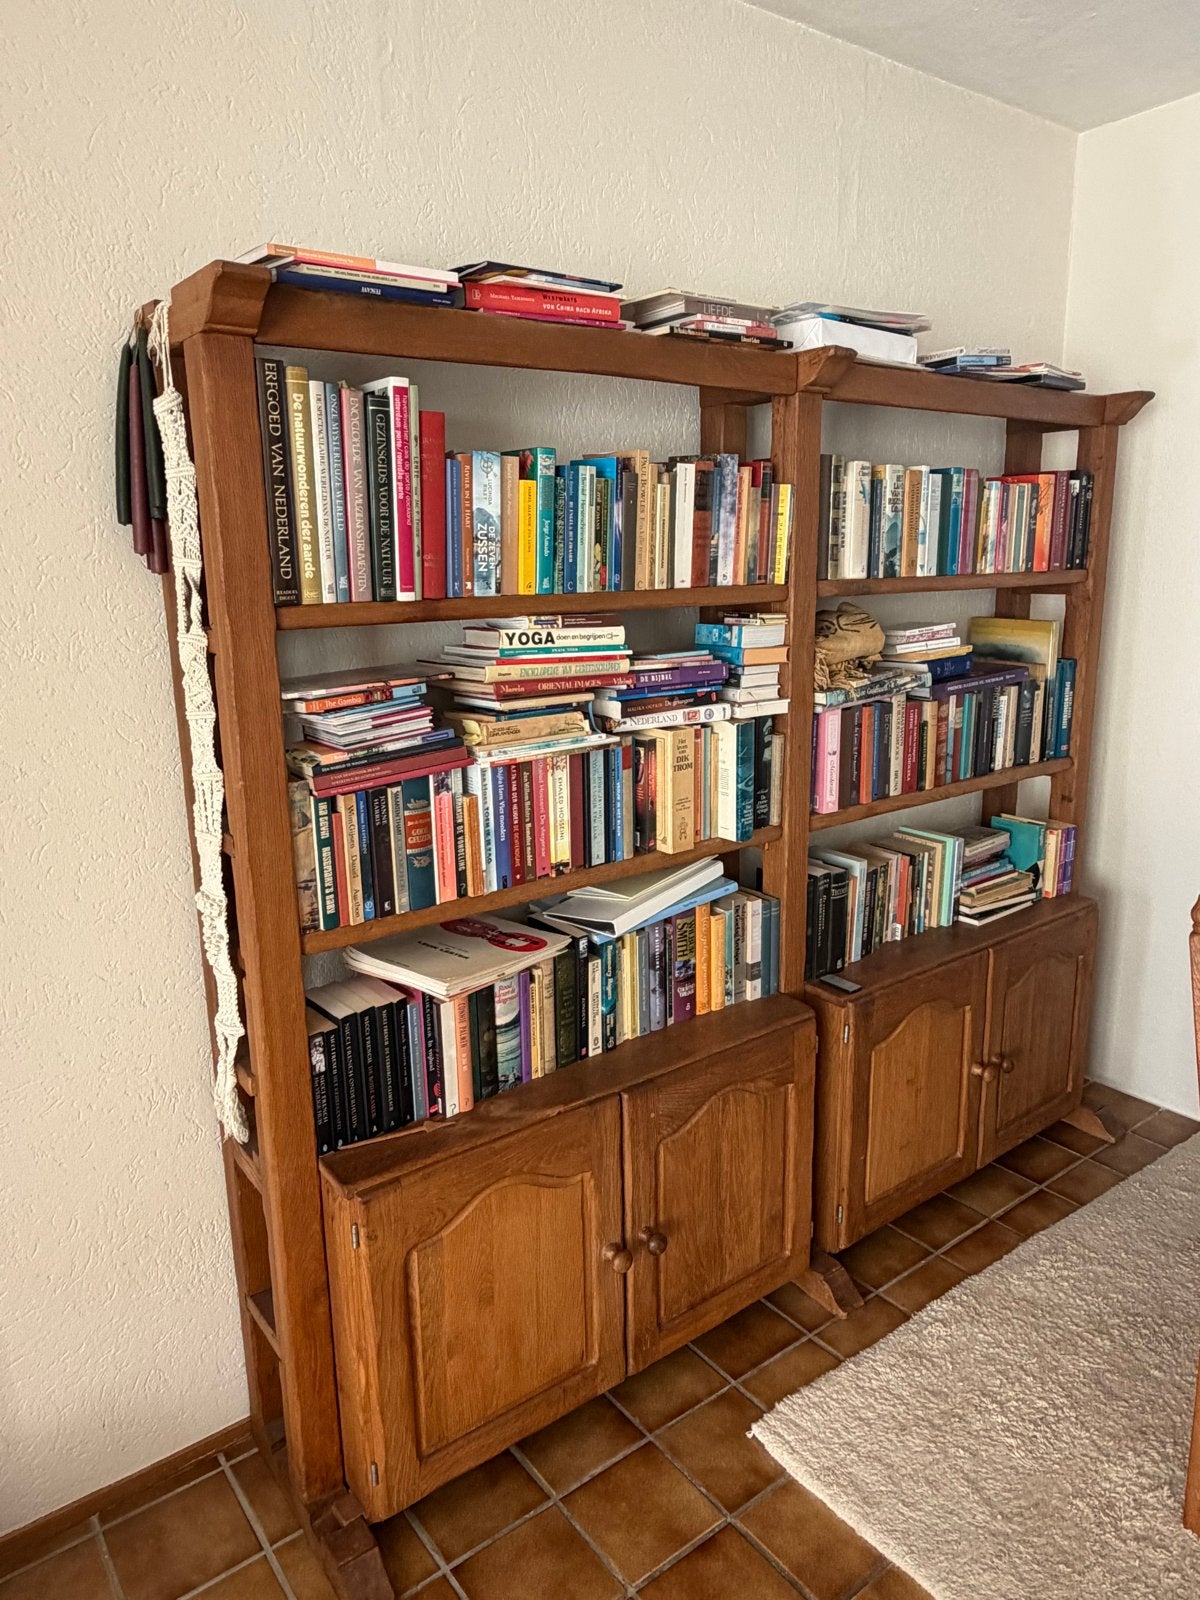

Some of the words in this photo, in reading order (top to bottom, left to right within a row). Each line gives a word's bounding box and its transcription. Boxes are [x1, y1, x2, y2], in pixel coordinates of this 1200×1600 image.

[703, 303, 735, 317] LIEFDE
[264, 363, 282, 436] ERFGOED
[293, 393, 306, 410] De
[330, 393, 339, 419] ONZE
[316, 406, 328, 467] SPECTACULAIRE
[349, 397, 361, 465] ENCYCLOPEDIE
[271, 443, 284, 477] VAN
[331, 420, 343, 488] MYSTERIEUZE
[375, 414, 388, 483] GEZINSGIDS
[293, 413, 312, 525] natuurwonderen
[354, 470, 362, 488] VAN
[640, 456, 648, 478] PAUL
[320, 468, 329, 501] WERELD
[465, 491, 470, 499] IN
[639, 479, 647, 513] BOWLES
[335, 490, 344, 531] WERELD
[378, 487, 390, 517] VOOR
[274, 485, 292, 579] NEDERLAND
[302, 527, 313, 541] der
[380, 520, 391, 535] DE
[488, 526, 496, 539] DE
[323, 528, 332, 560] NATUUR
[354, 492, 367, 592] MUZIEKINSTRUMENTEN
[477, 523, 488, 572] ZUSSEN
[488, 541, 496, 569] ZEVEN
[302, 543, 316, 579] aarde
[382, 538, 392, 584] NATUUR
[505, 632, 555, 645] YOGA
[579, 633, 606, 641] begrijpen
[520, 666, 561, 678] ENCYCLOPEDIE
[562, 665, 572, 674] VAN
[574, 663, 621, 673] GEREEDSCHAPPEN
[651, 674, 672, 682] BIJBEL
[538, 681, 573, 691] ORIENTAL
[574, 679, 601, 689] IMAGES
[325, 699, 337, 708] The
[630, 714, 678, 726] NEDERLAND
[673, 763, 693, 772] TROM
[318, 802, 328, 815] IRA
[379, 796, 387, 825] JOANNE
[540, 815, 545, 825] De
[319, 815, 330, 839] LEVIN
[457, 826, 464, 834] DE
[457, 836, 465, 872] VONDELING
[322, 847, 334, 893] ROSEMARY'S
[326, 895, 335, 914] BABY
[735, 905, 740, 913] De
[677, 922, 688, 958] SMITH
[605, 945, 613, 977] Rosemary
[457, 1002, 466, 1024] CONNIE
[460, 1026, 468, 1048] PALMEN
[346, 1046, 354, 1077] FRENCH
[427, 1049, 435, 1071] vrijheid
[348, 1078, 357, 1128] ONDERHUIDS
